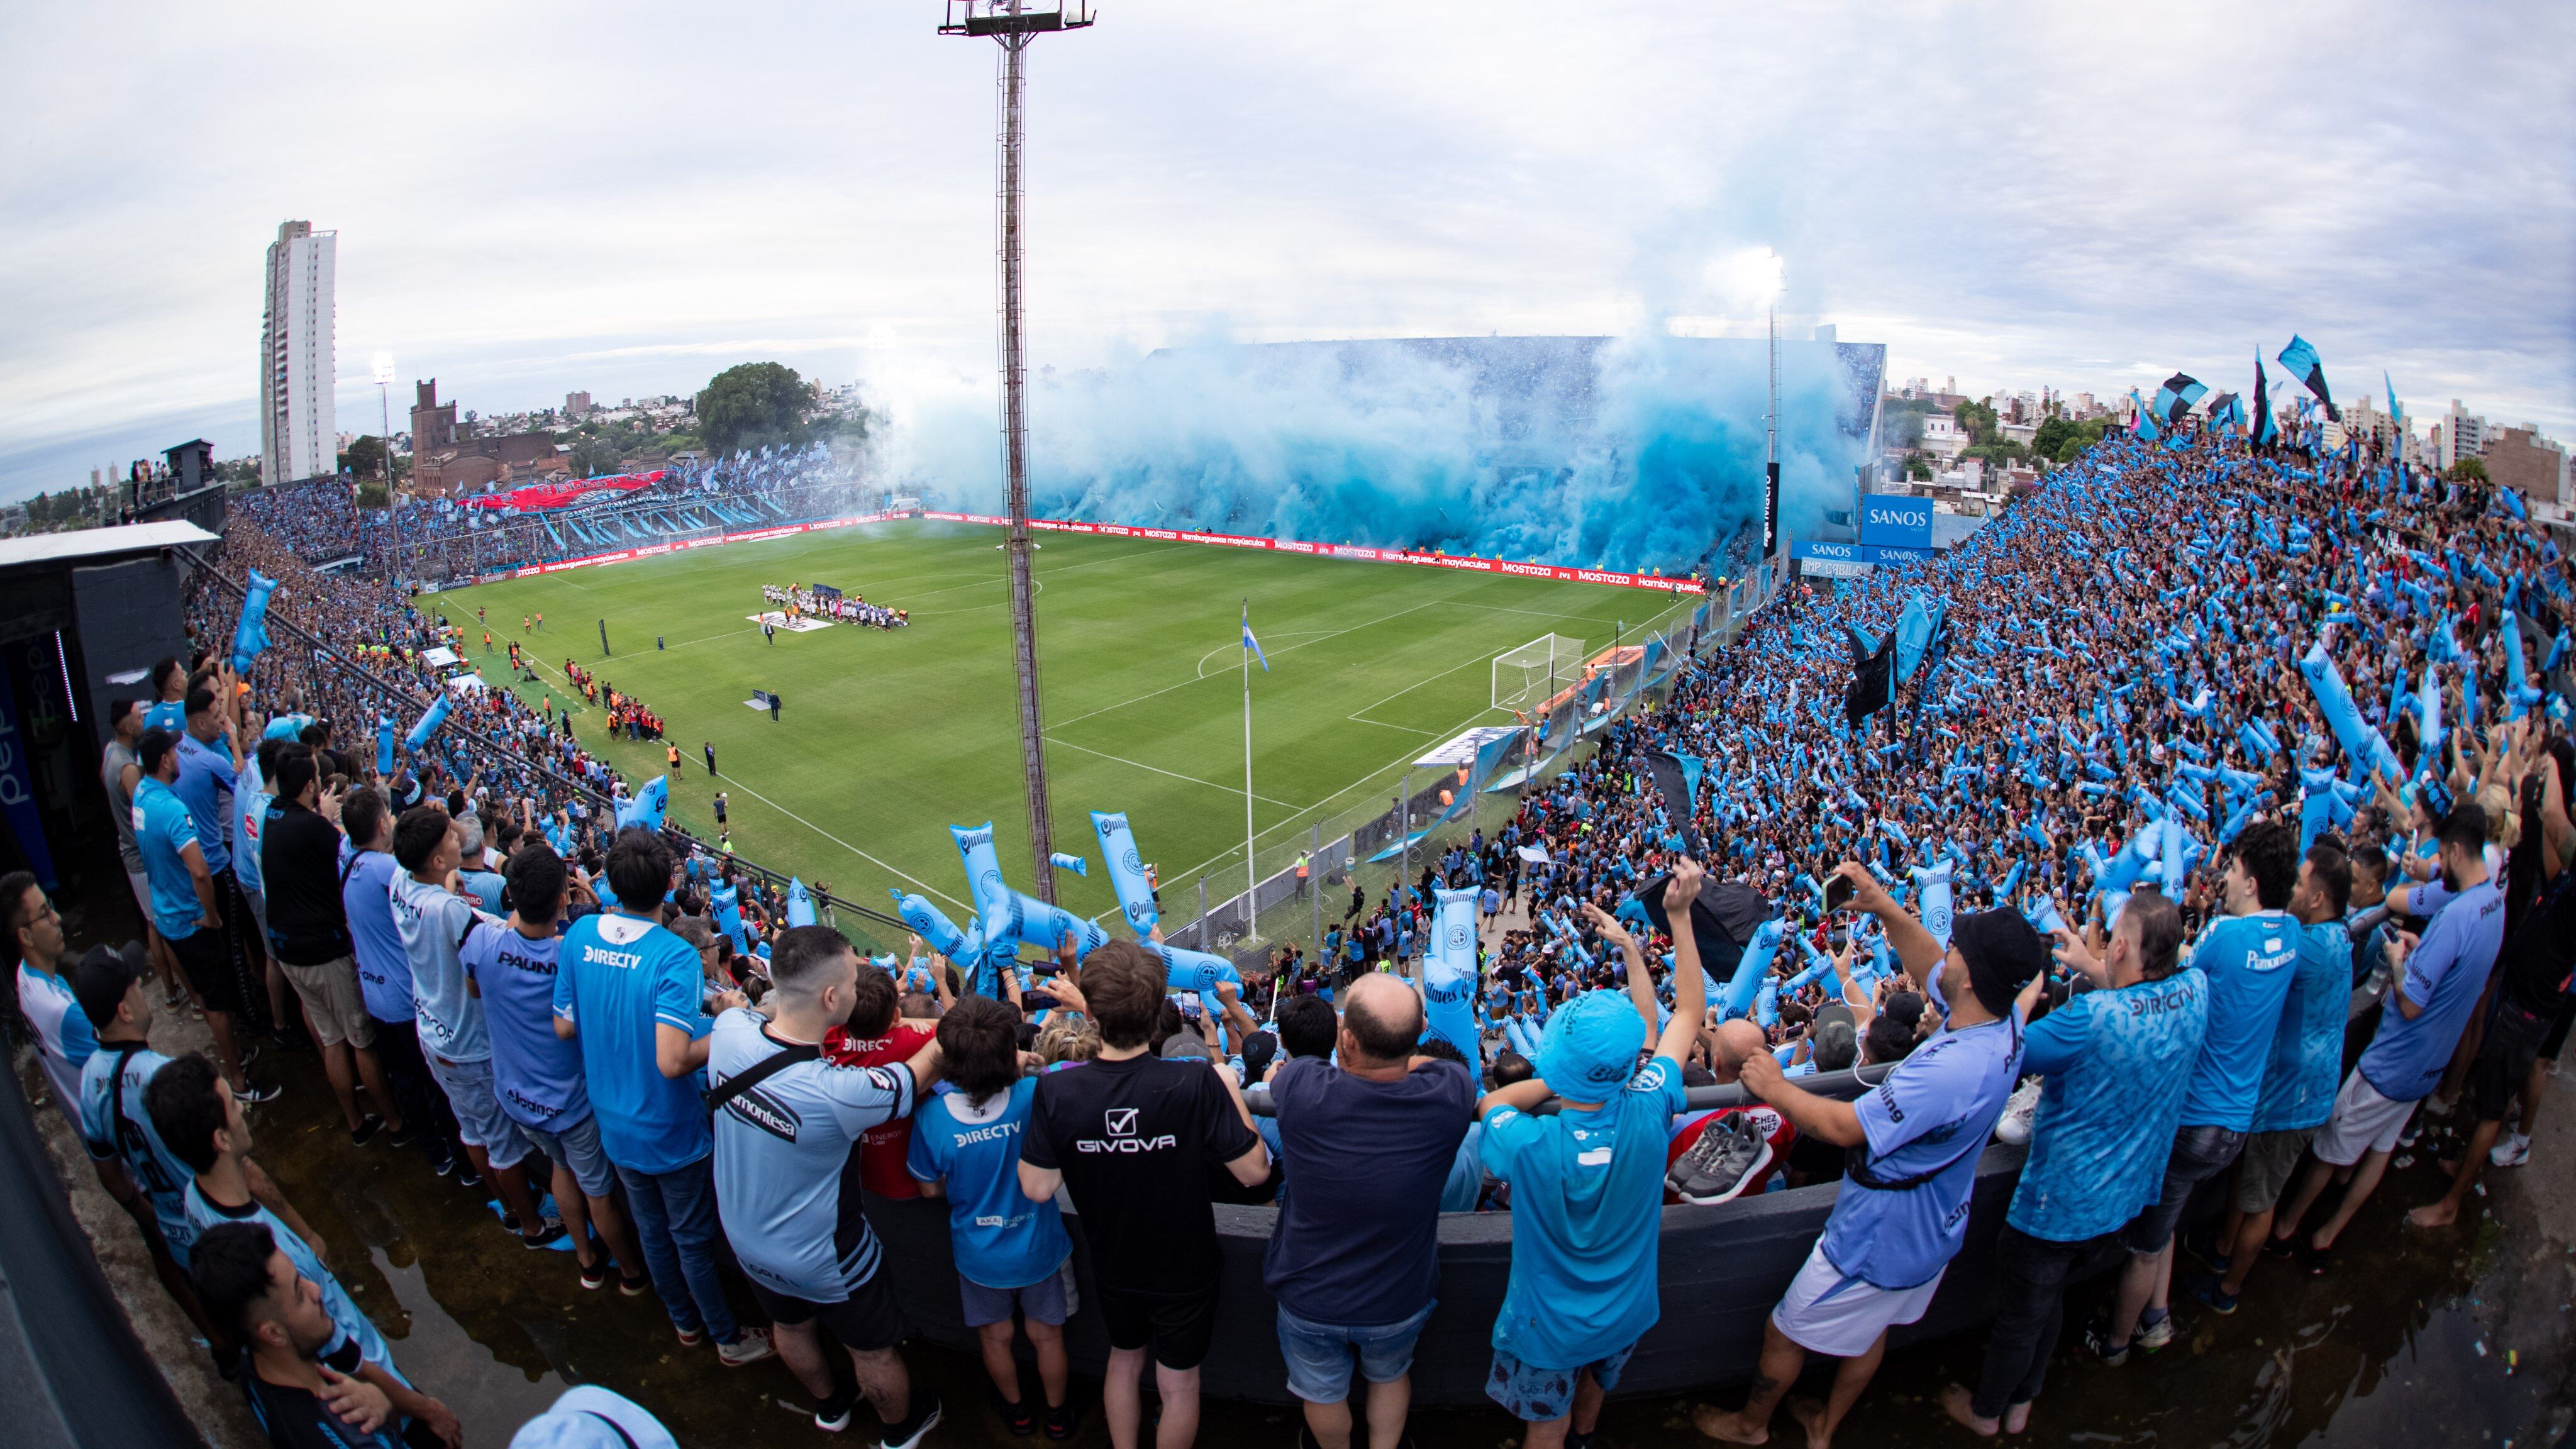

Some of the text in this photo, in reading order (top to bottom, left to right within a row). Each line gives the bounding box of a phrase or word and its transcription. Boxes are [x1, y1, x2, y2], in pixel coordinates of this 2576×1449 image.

[1870, 509, 1926, 527] SANOS
[1181, 533, 1266, 548] Hamburguesas mayúsculas
[1812, 544, 1851, 558] SANOS
[1880, 549, 1918, 562] SANOS
[545, 559, 591, 572] Hamburguesas
[1442, 558, 1491, 570] mayúsculas
[479, 572, 508, 585] Schneider
[583, 945, 642, 970] DIRECTV
[2246, 947, 2296, 970] Piamontesa
[870, 1130, 902, 1141] ENERGY
[953, 1120, 1021, 1148] DIRECTV
[1076, 1134, 1176, 1153] GIVOVA
